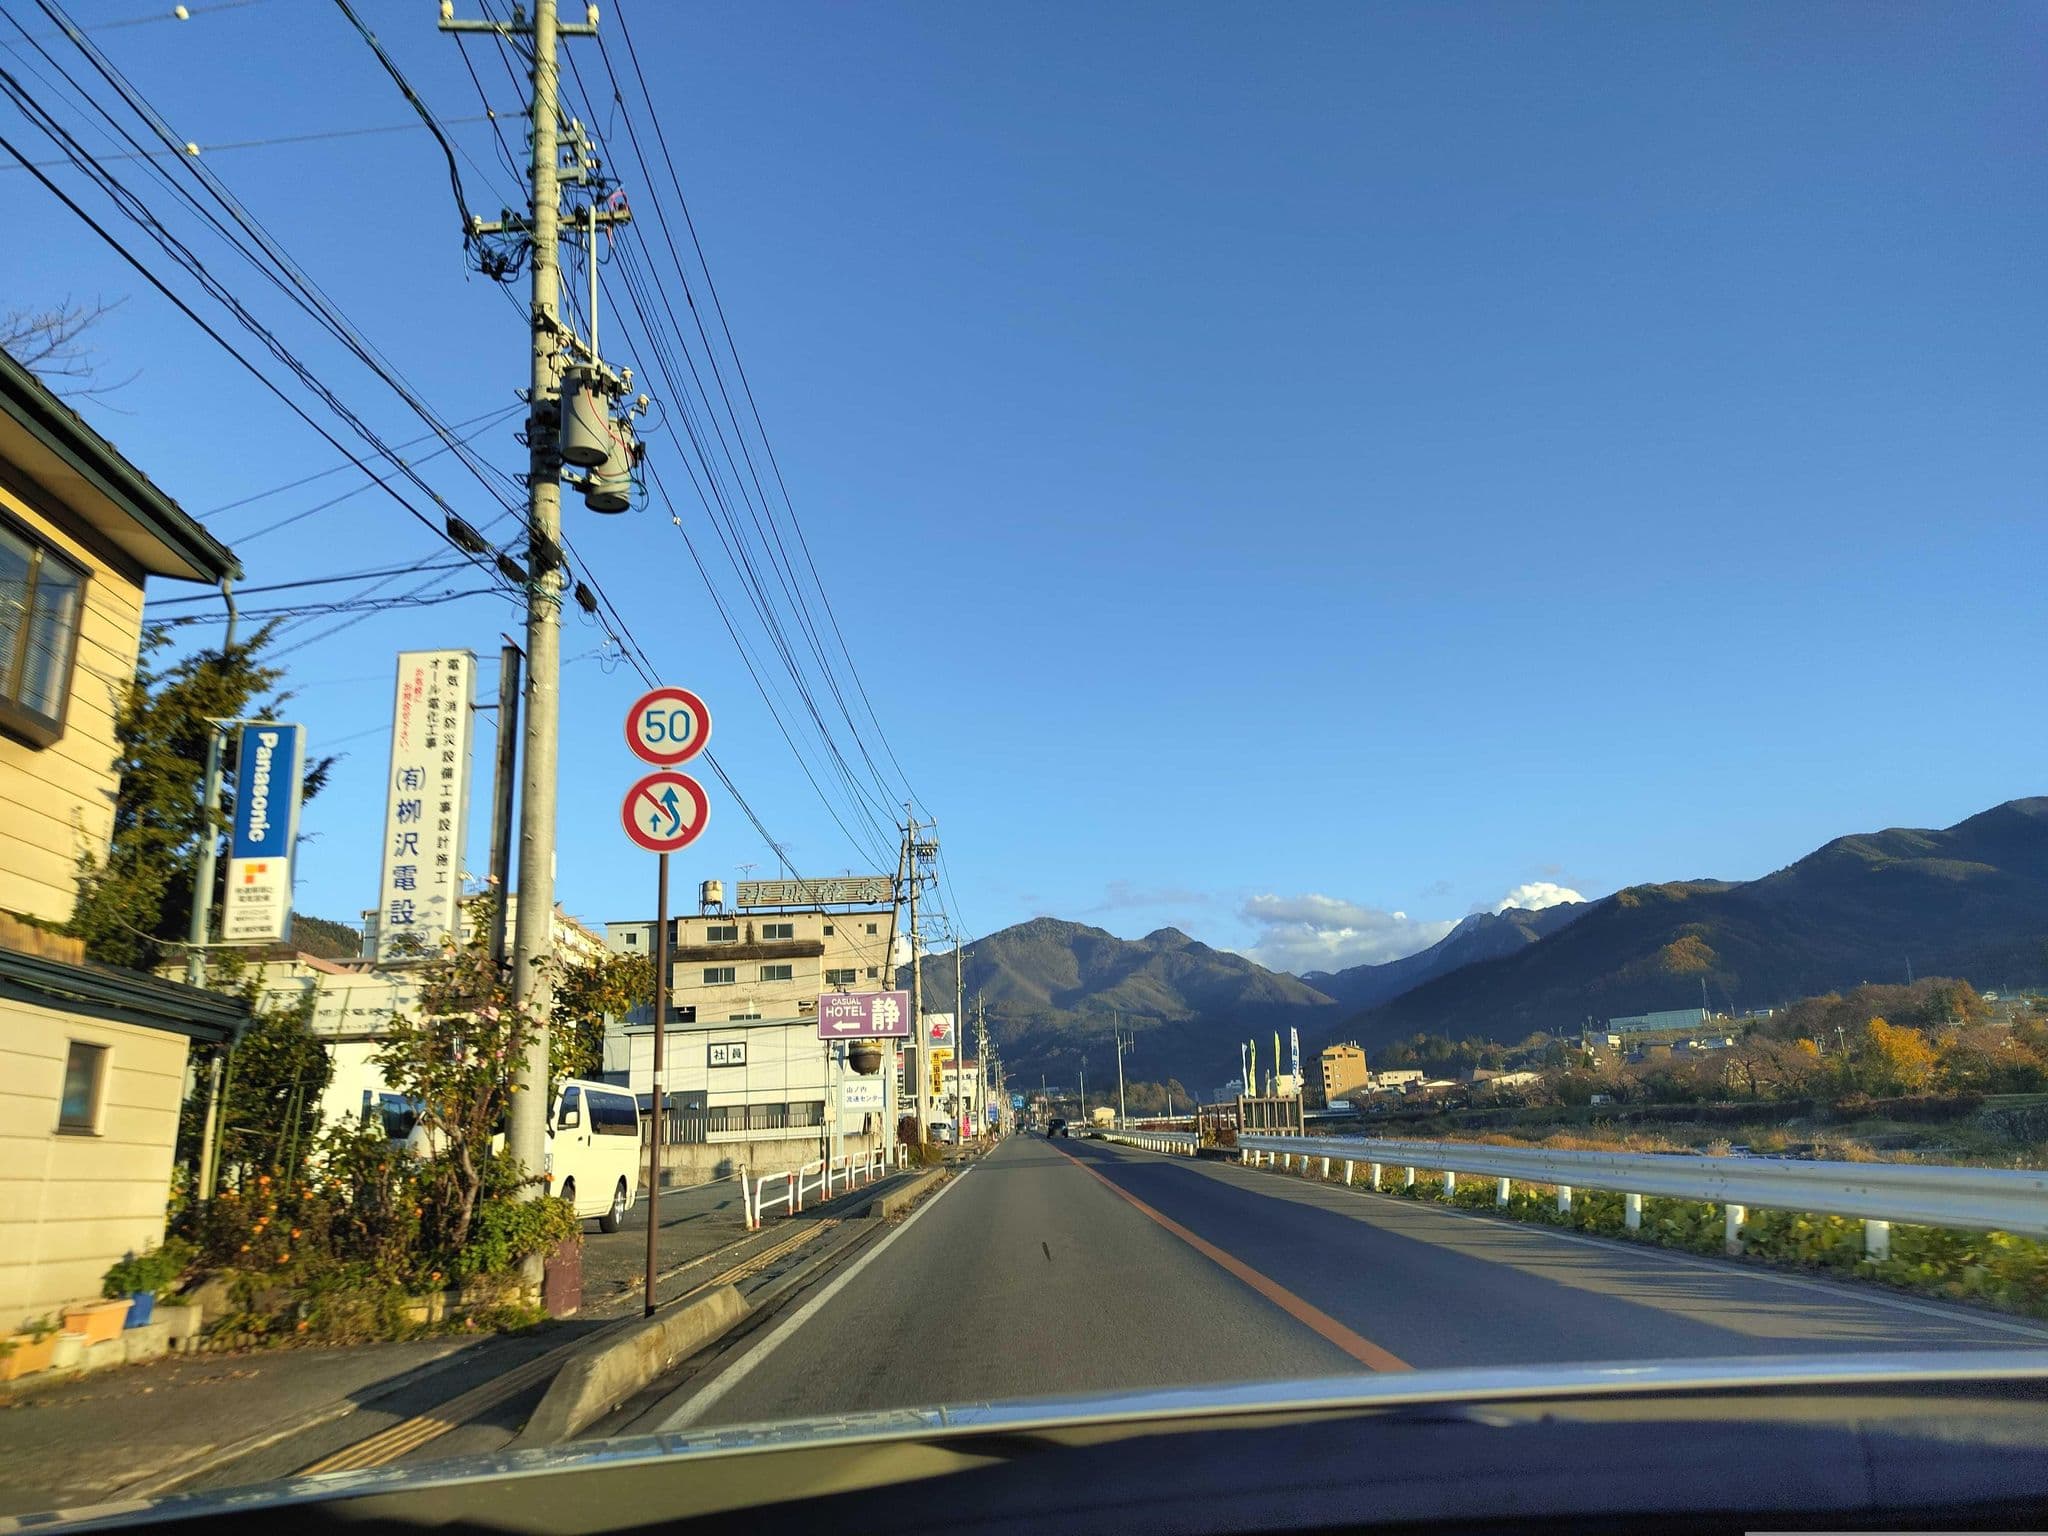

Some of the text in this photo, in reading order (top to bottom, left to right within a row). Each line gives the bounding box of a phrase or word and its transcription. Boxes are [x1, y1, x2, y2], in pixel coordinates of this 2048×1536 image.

[645, 710, 691, 743] 50
[248, 731, 279, 843] Panasonic
[825, 1005, 867, 1018] HOTEL
[831, 997, 862, 1006] CASUAL
[871, 997, 900, 1031] 静
